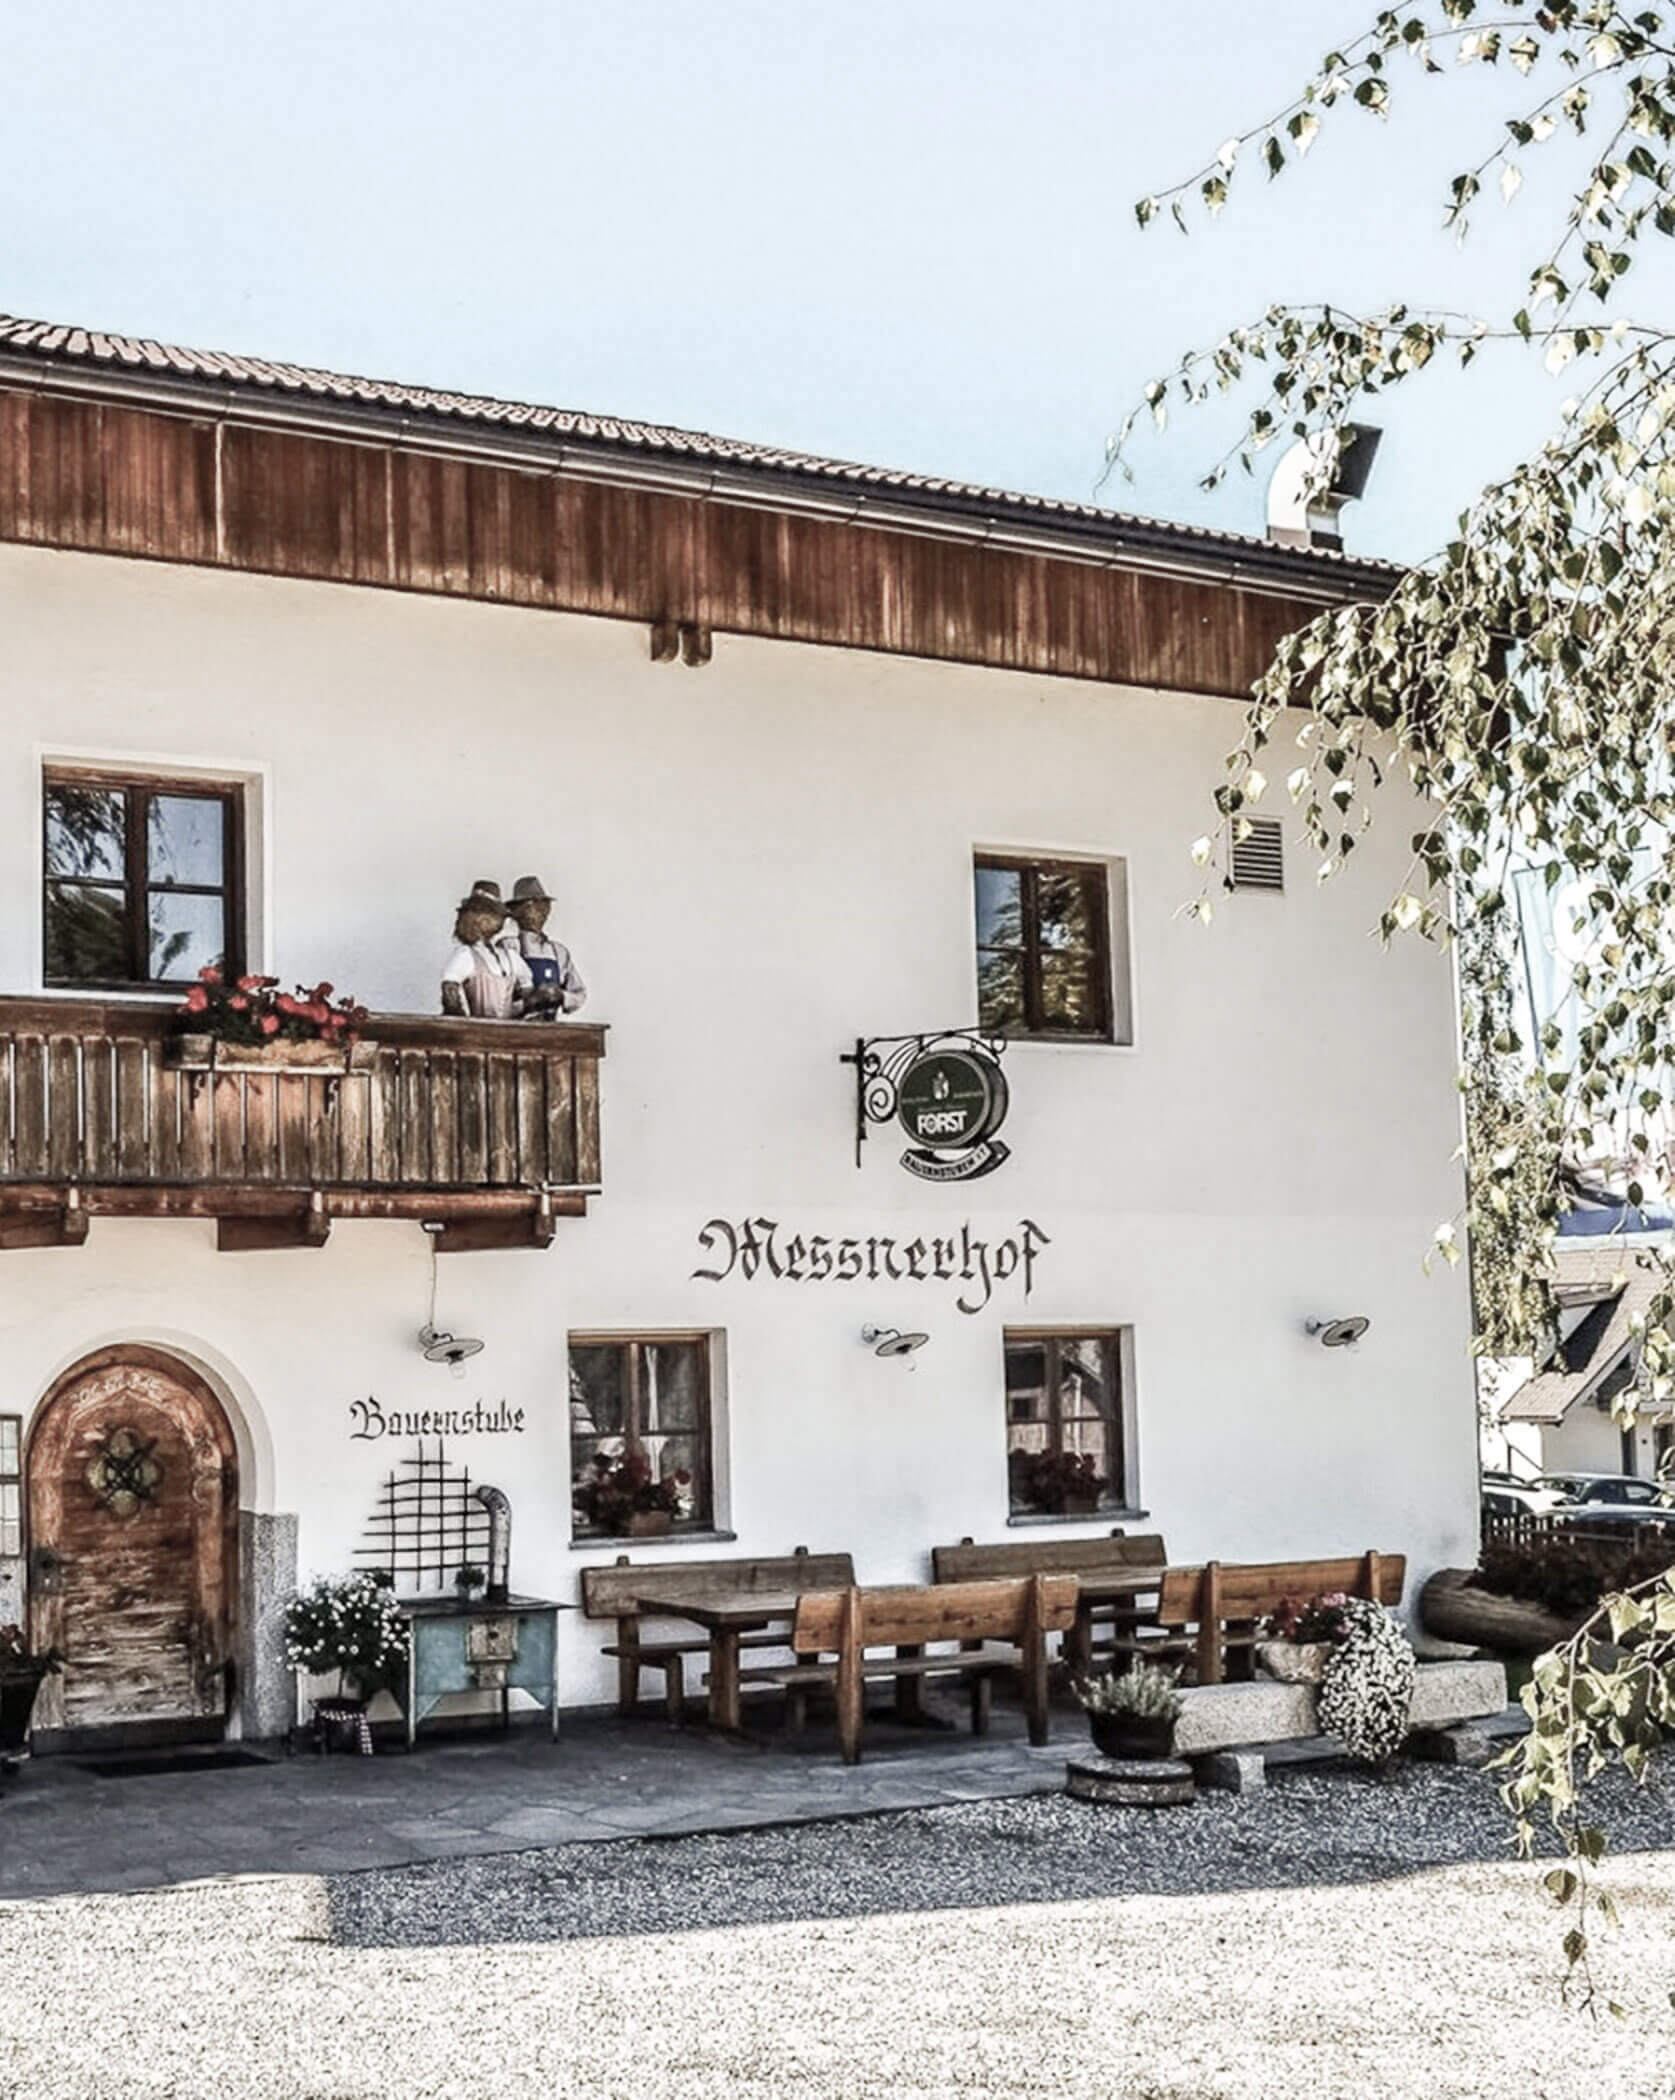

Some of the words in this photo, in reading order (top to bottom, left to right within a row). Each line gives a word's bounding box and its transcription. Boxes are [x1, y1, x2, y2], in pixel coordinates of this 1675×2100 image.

[917, 1110, 968, 1135] FORST
[689, 1217, 1052, 1314] Messnerhof
[349, 1395, 526, 1440] Bauernstube
